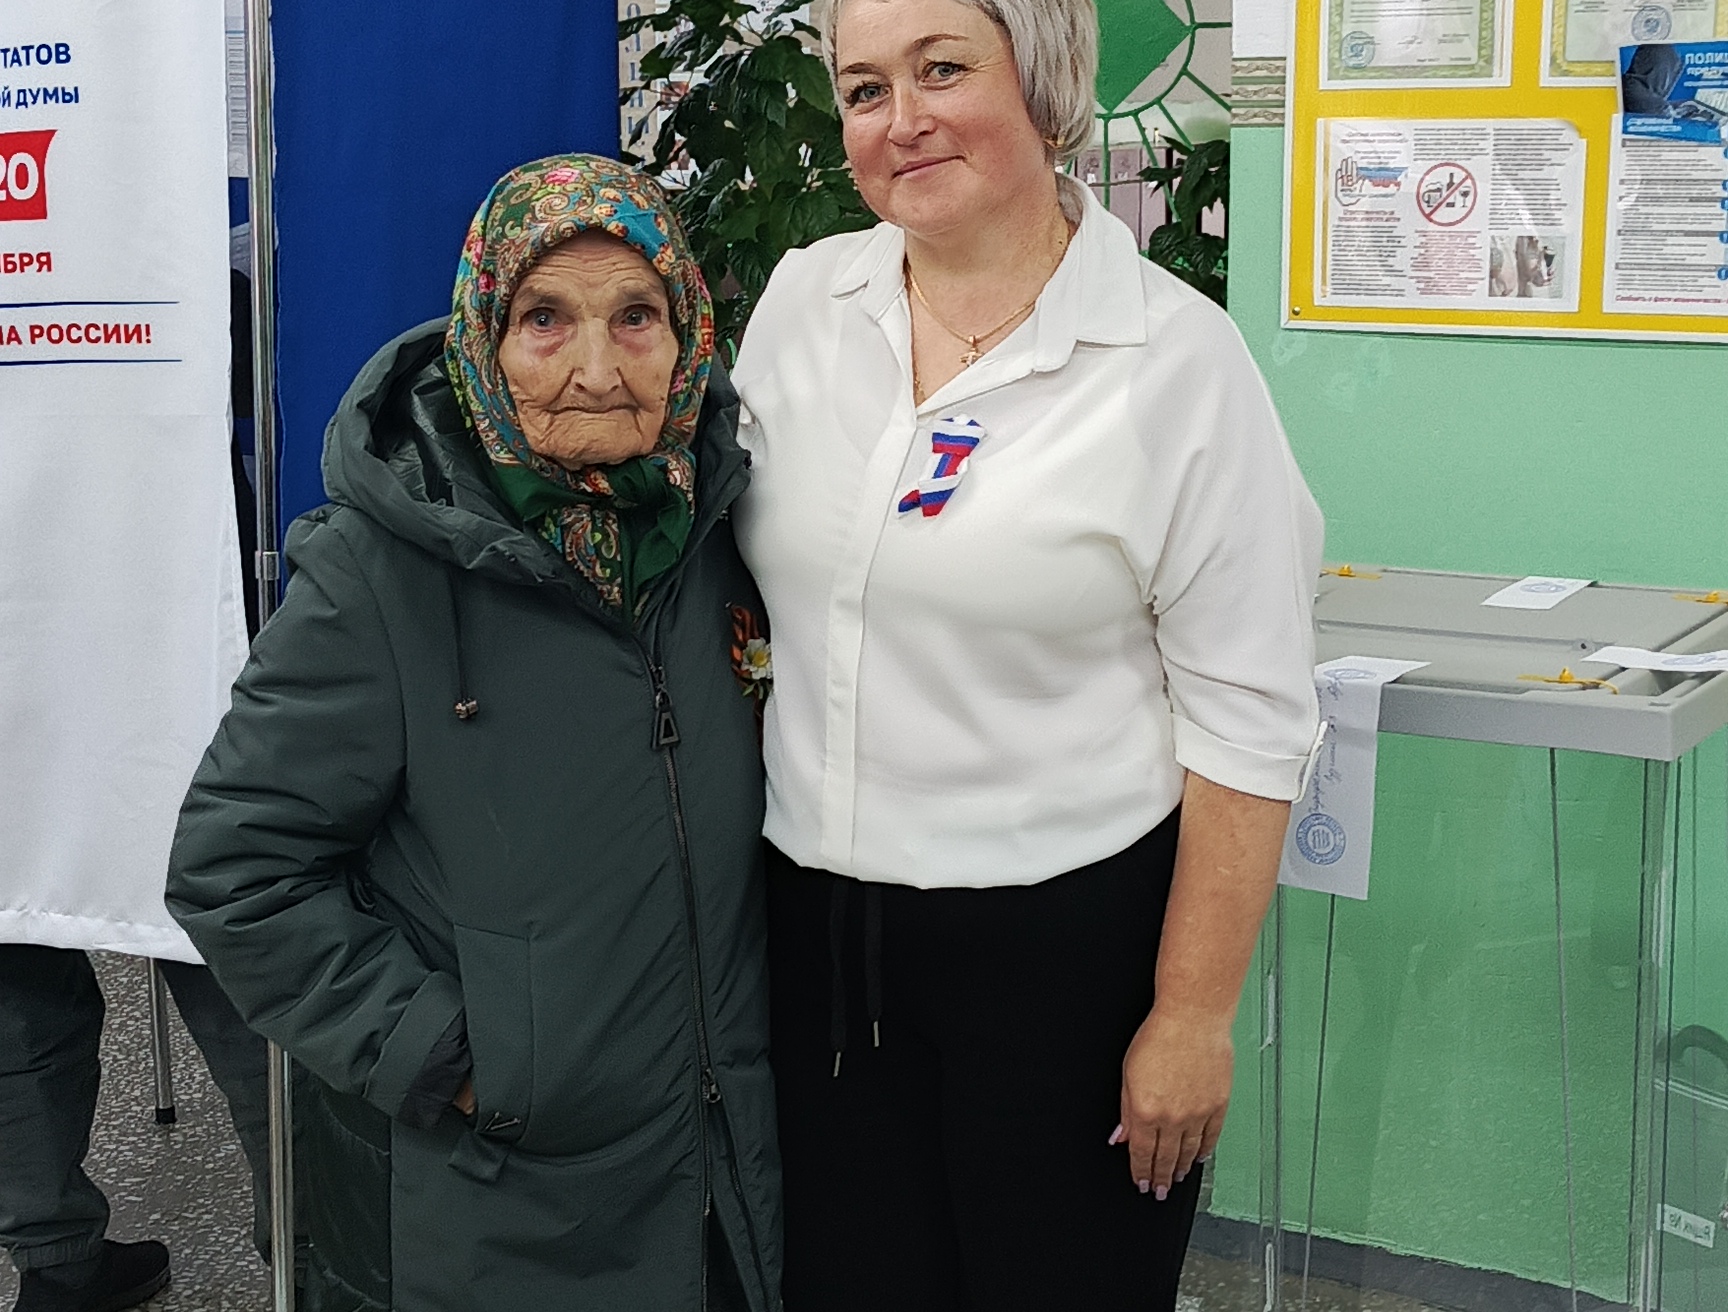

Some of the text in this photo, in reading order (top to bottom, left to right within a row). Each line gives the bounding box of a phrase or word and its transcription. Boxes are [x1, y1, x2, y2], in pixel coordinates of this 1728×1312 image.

[0, 86, 79, 109] Й ДУМЫ
[0, 152, 39, 201] 0
[0, 251, 52, 273] БРЯ
[0, 323, 152, 345] А РОССИИ!
